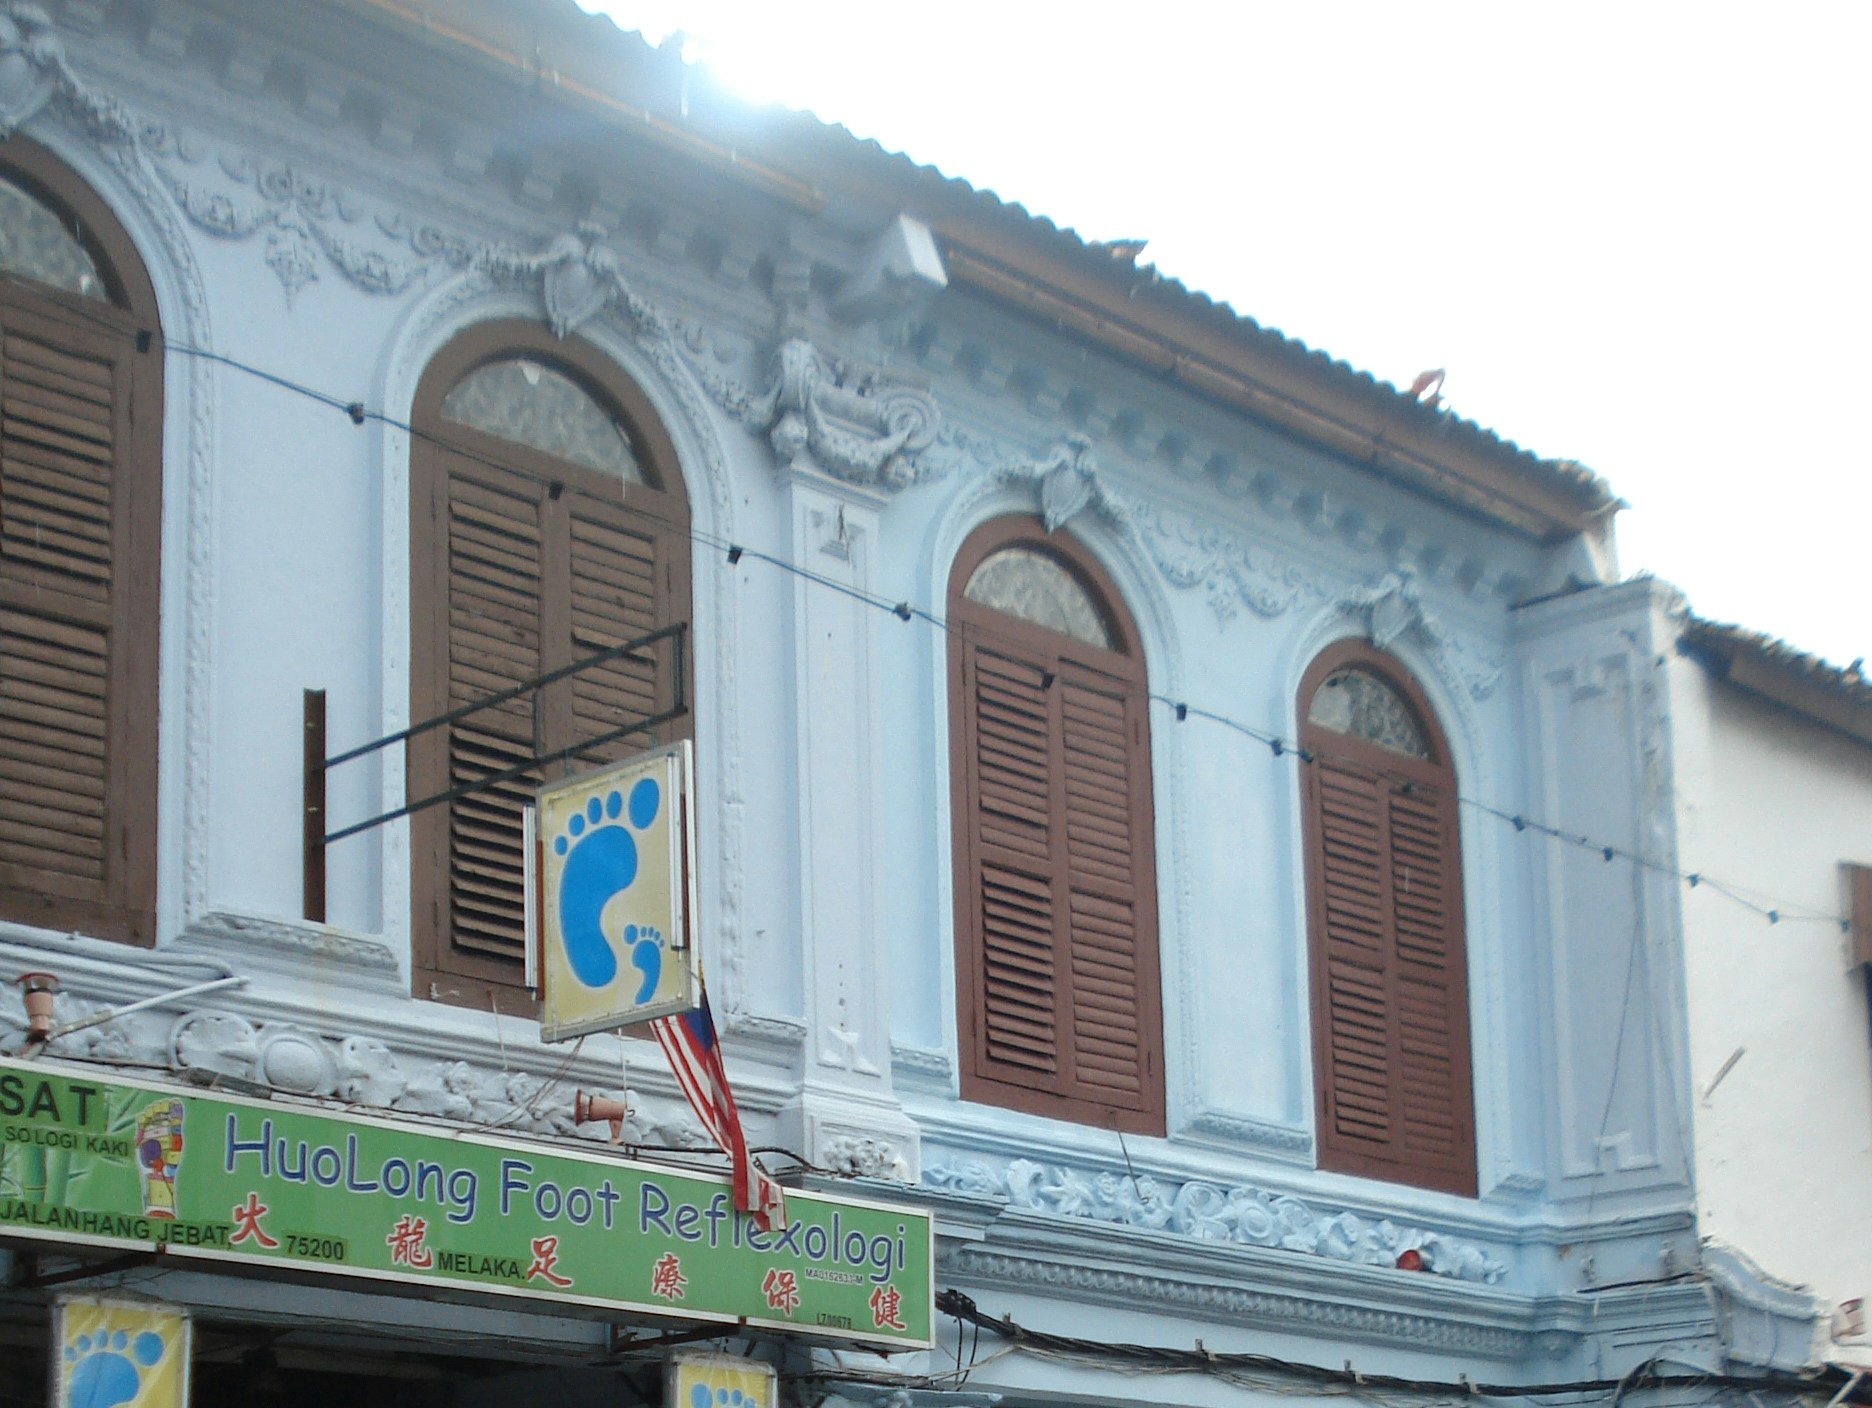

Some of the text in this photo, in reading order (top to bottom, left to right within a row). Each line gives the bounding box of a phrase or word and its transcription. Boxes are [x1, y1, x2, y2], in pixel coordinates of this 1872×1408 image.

[86, 1136, 129, 1157] KAKI
[225, 1112, 907, 1282] HuoLong Foot Reflexologi
[286, 1234, 344, 1260] 75200
